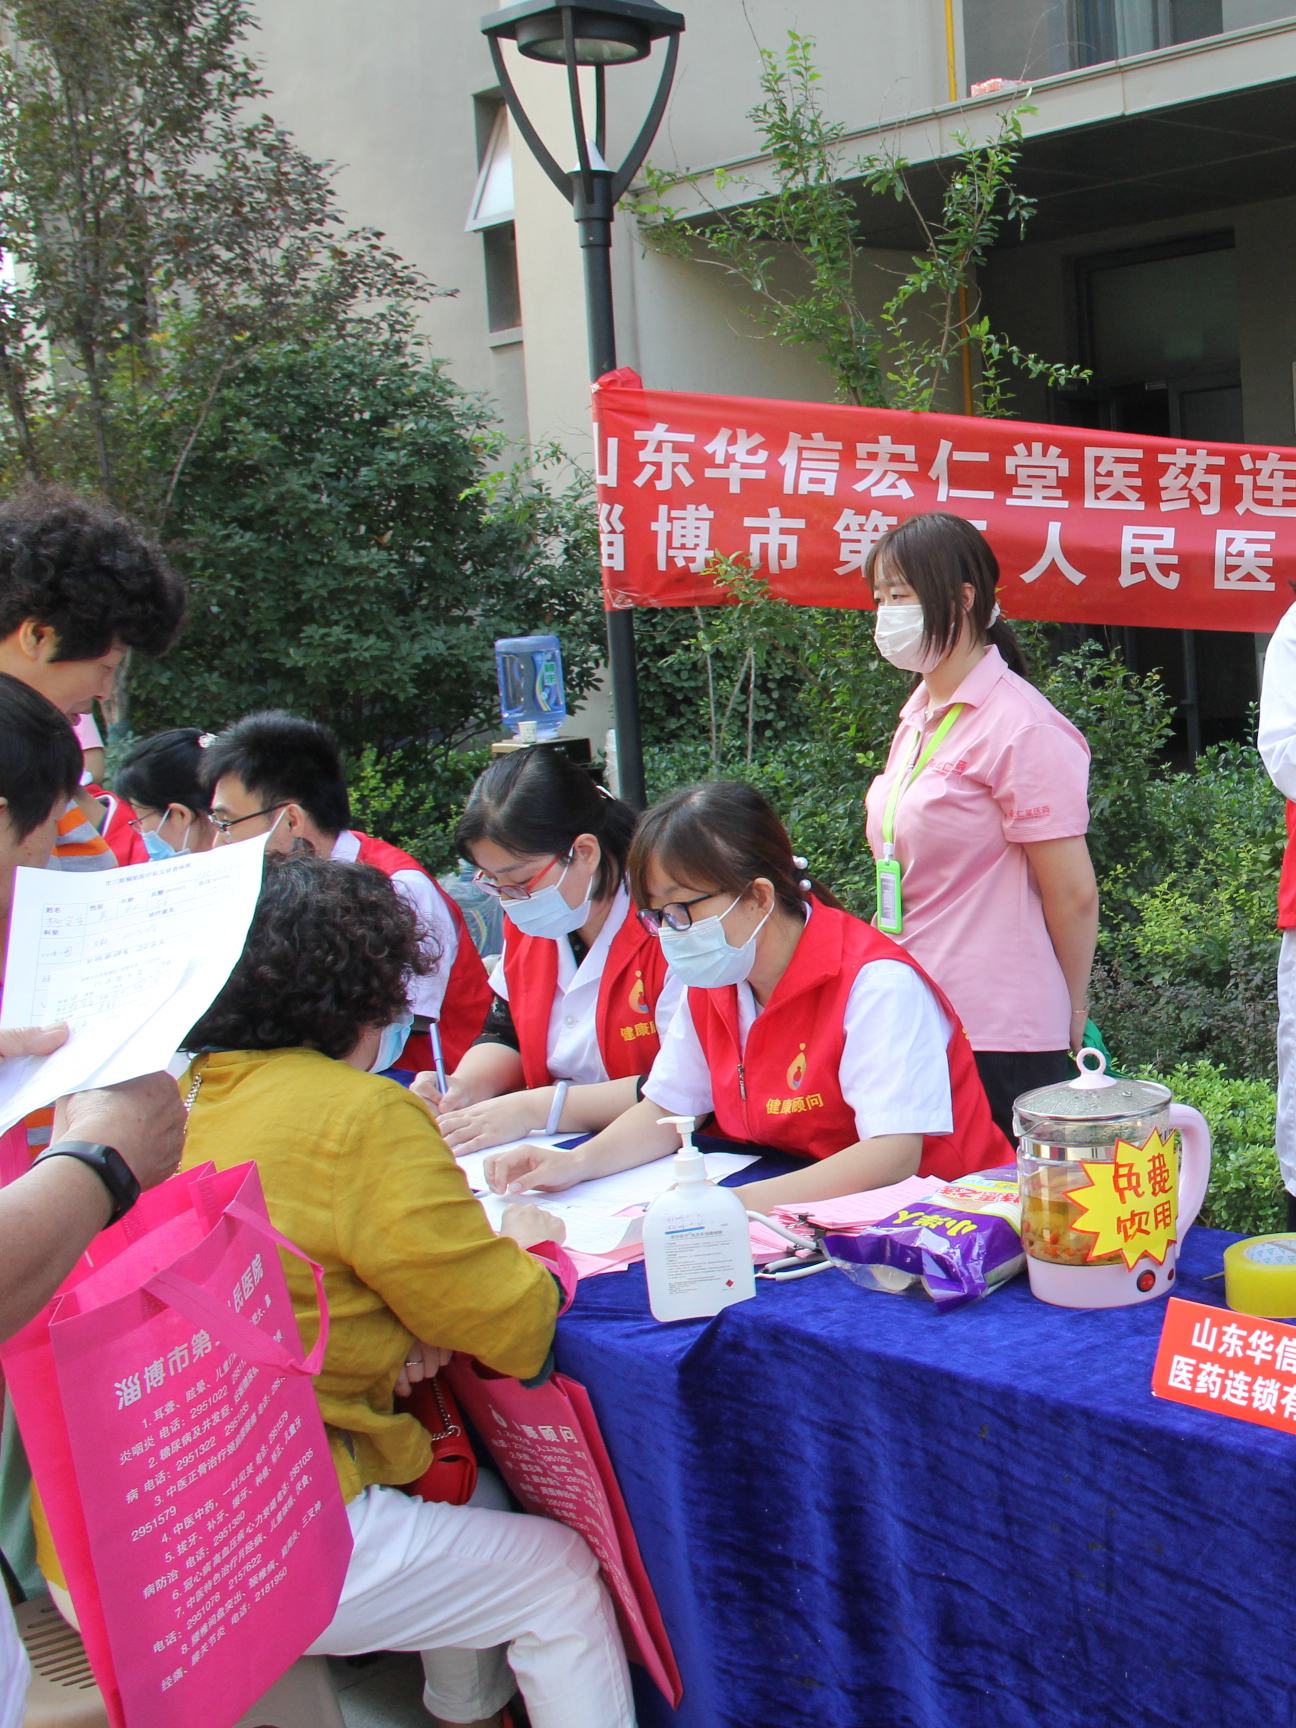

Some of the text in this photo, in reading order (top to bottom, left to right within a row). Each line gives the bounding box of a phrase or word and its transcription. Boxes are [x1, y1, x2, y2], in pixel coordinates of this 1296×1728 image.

[765, 1093, 824, 1115] 健康顾问
[1112, 1153, 1172, 1204] 免费
[1116, 1199, 1172, 1243] 饮用
[113, 1253, 266, 1411] 淄博市第民医院
[512, 1420, 579, 1443] 康顾问
[131, 1505, 178, 1542] 2951579
